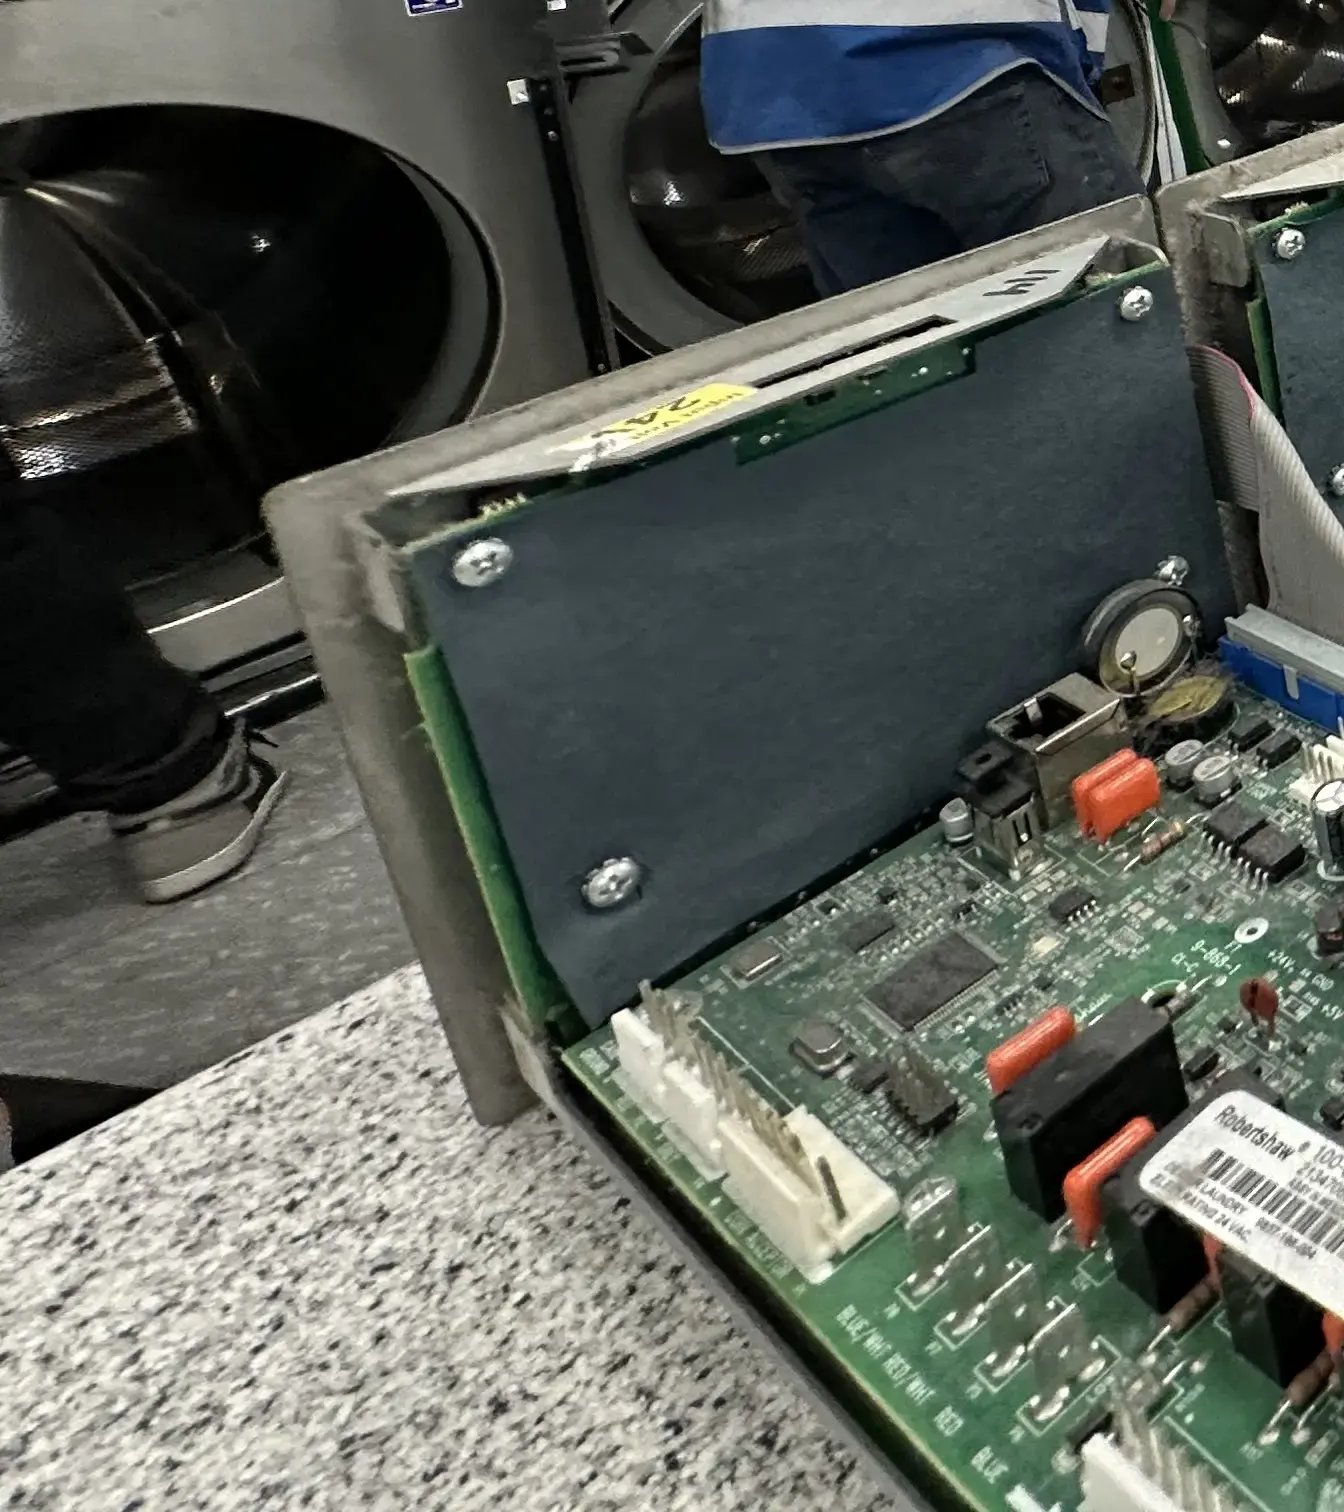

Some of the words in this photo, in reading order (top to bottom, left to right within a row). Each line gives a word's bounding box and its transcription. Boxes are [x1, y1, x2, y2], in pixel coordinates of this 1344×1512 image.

[1214, 1104, 1296, 1162] Robertshaw
[933, 1405, 965, 1437] RED
[970, 1445, 1009, 1484] BLUE
